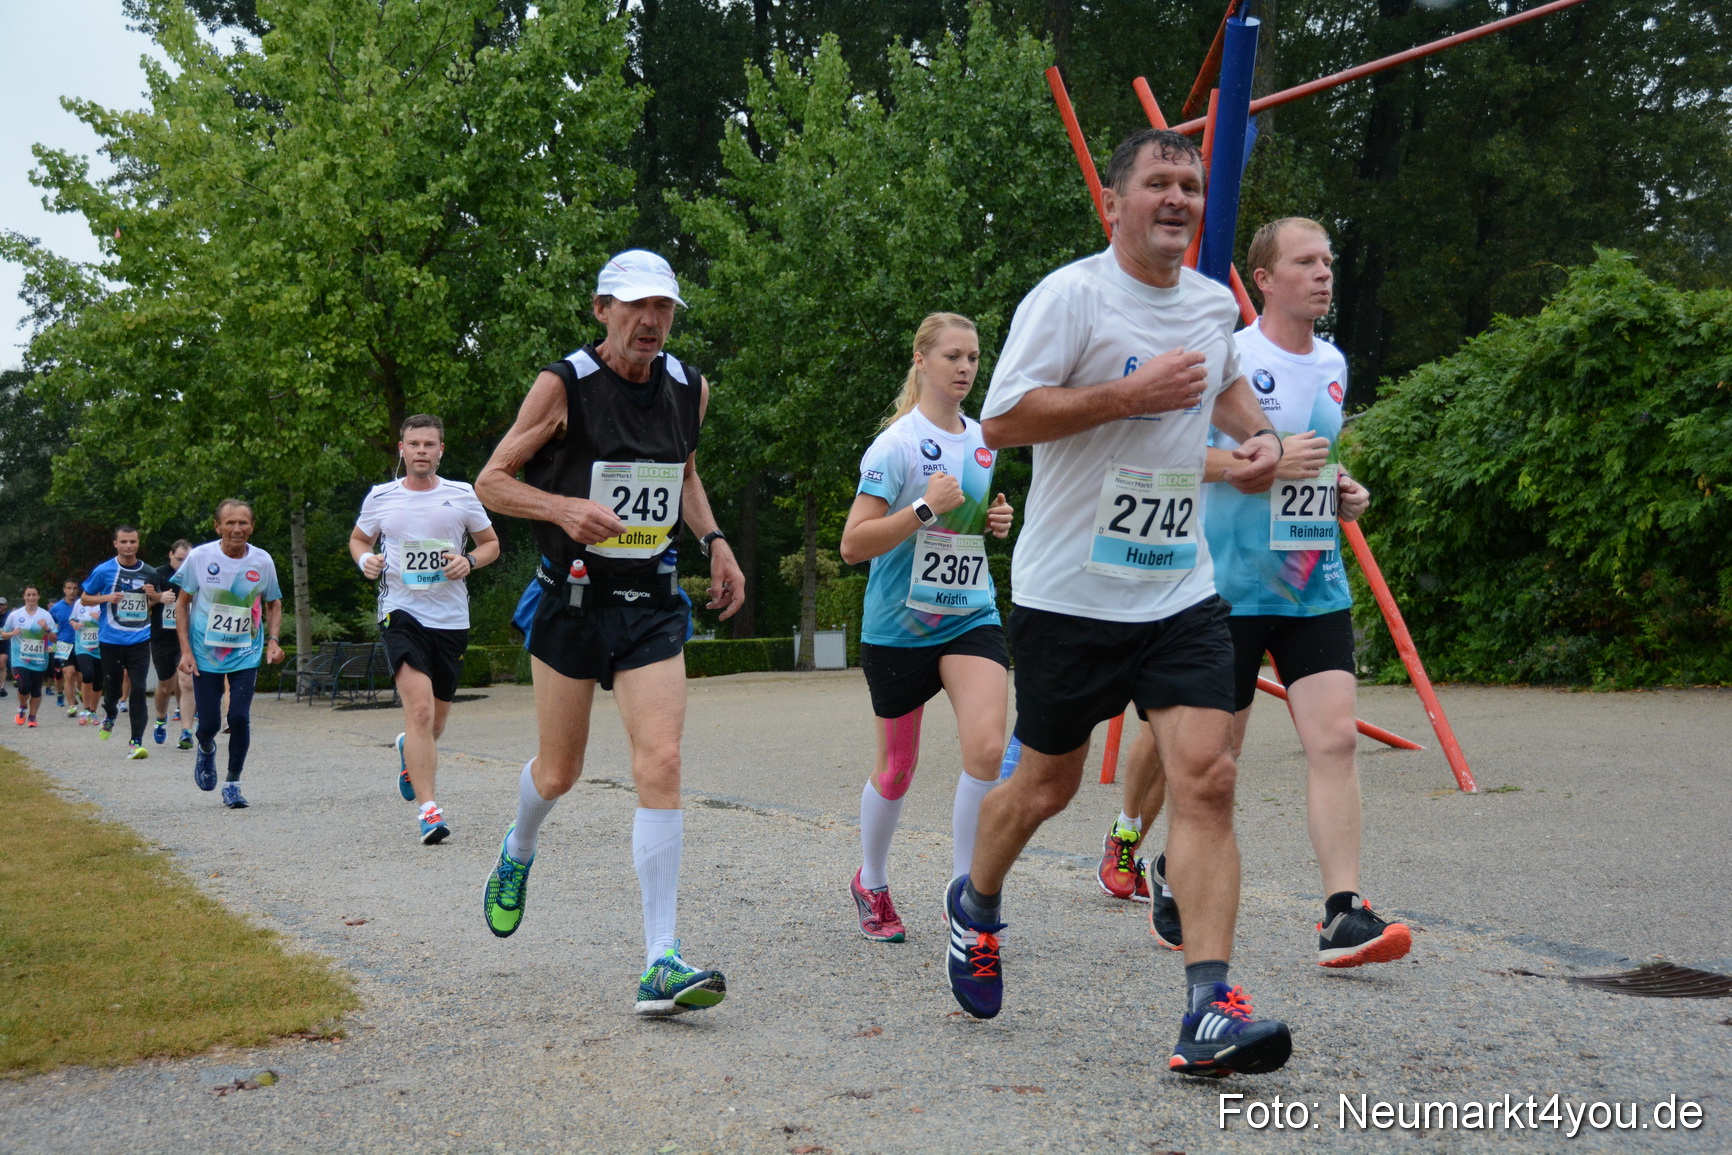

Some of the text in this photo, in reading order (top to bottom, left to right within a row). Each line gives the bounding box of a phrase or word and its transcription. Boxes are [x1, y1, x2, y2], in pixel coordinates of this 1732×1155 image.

[1257, 398, 1281, 406] ARTL
[637, 466, 679, 478] BOCK
[923, 464, 948, 472] PARTL
[1115, 477, 1153, 489] NeuerMarkt
[1158, 473, 1196, 487] BOCK
[612, 485, 669, 522] 243
[1281, 485, 1336, 517] 2270
[1108, 494, 1193, 538] 2742
[618, 531, 658, 545] Lothar
[1290, 525, 1334, 538] Reinhard
[956, 538, 984, 548] BOCK
[405, 550, 450, 570] 2285
[1125, 547, 1175, 566] Hubert
[921, 552, 984, 586] 2367
[121, 600, 146, 610] 2579
[935, 592, 968, 605] Kristin
[212, 614, 251, 632] 2412
[83, 632, 98, 640] 228
[221, 635, 239, 643] Josef
[24, 644, 43, 653] 2441
